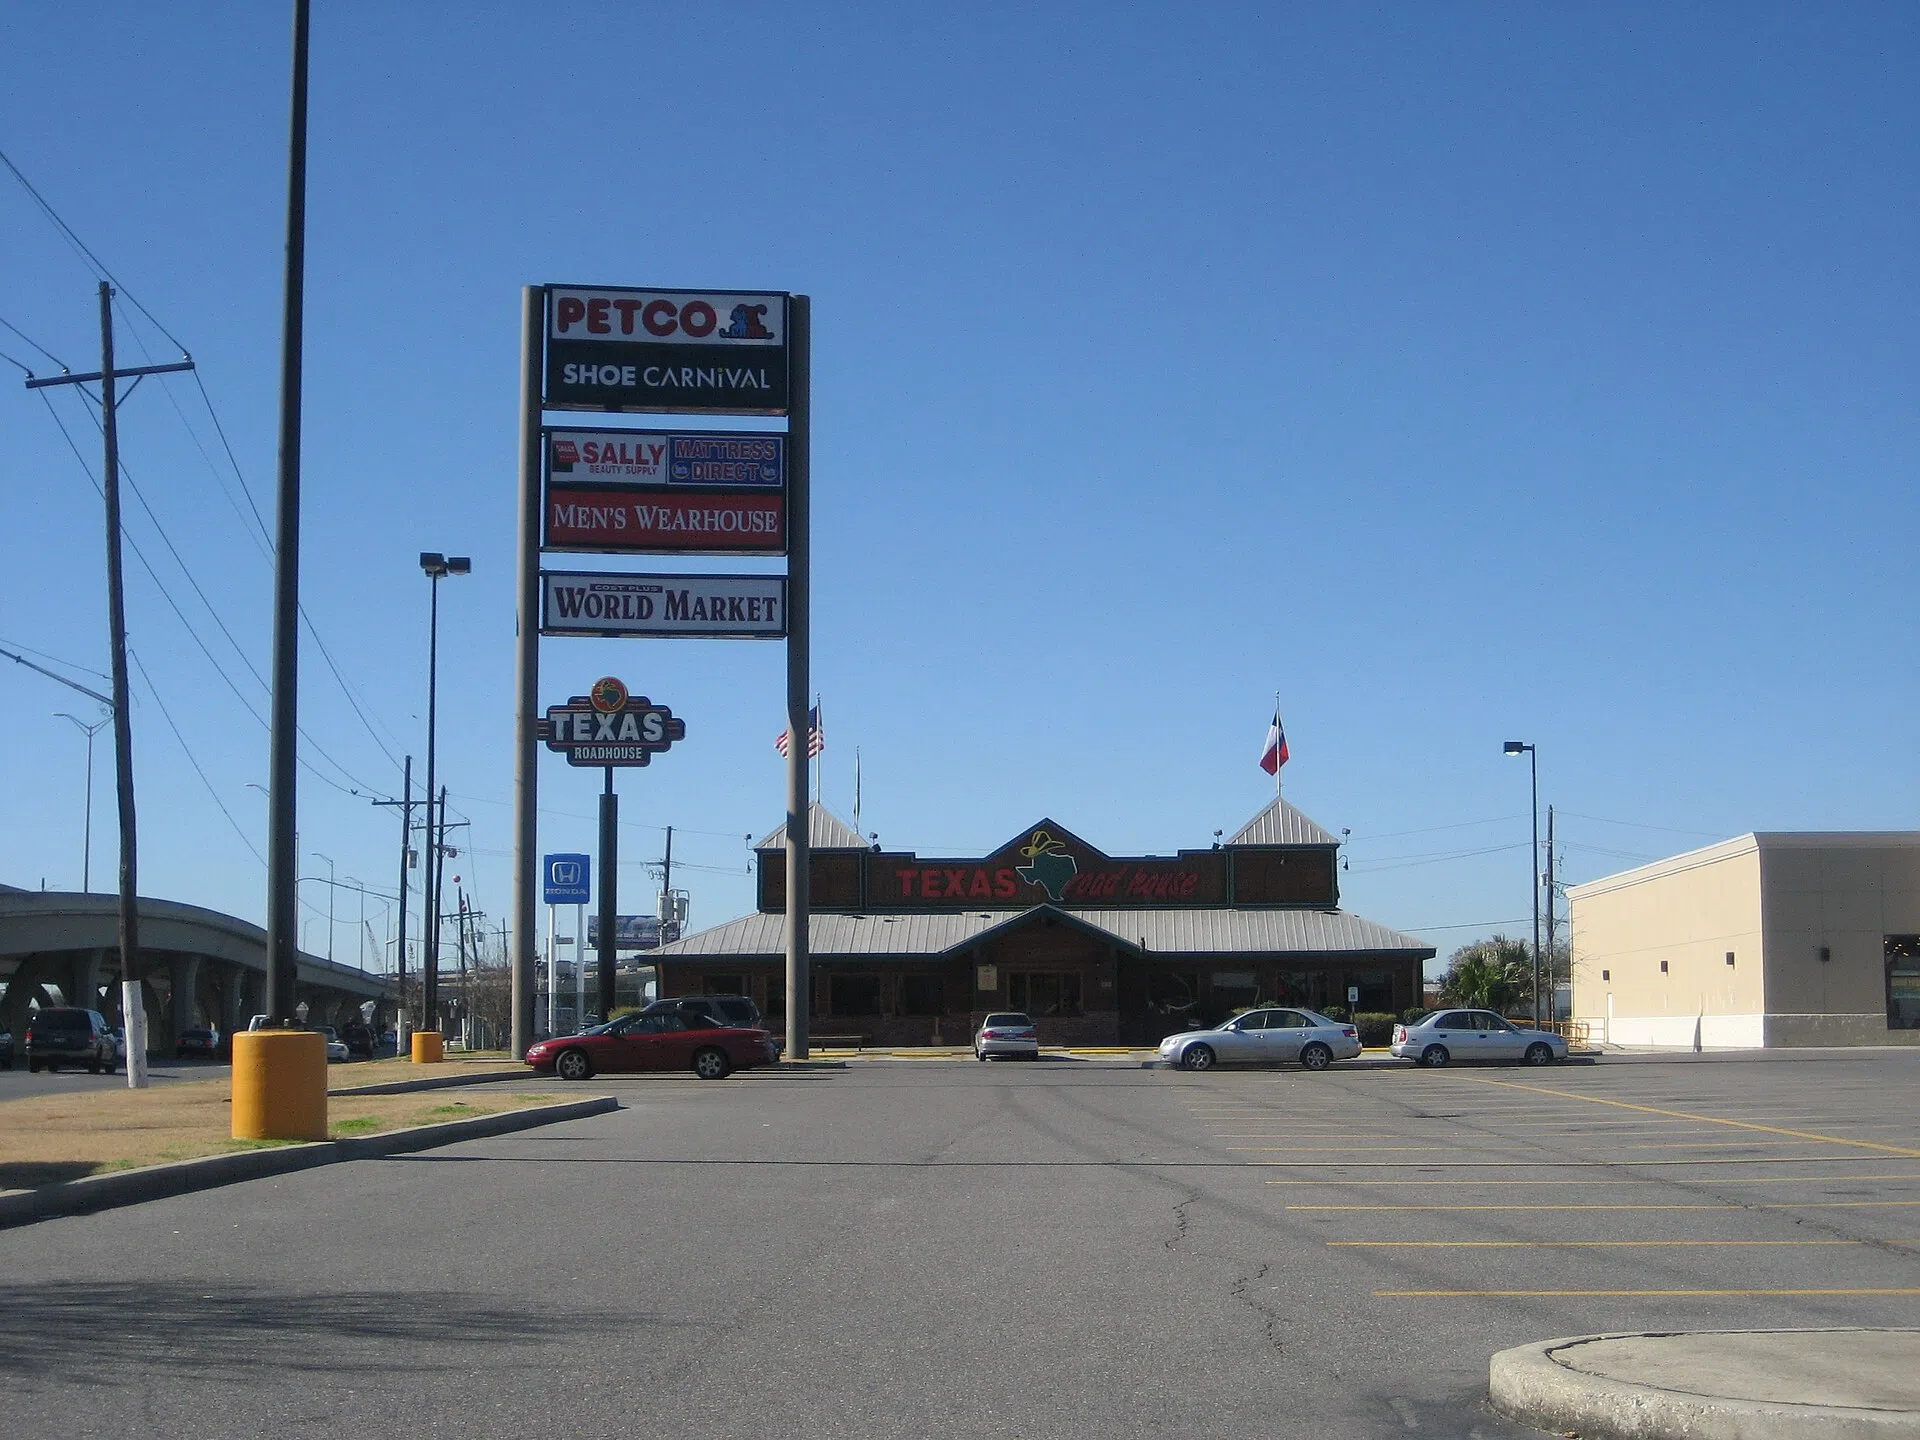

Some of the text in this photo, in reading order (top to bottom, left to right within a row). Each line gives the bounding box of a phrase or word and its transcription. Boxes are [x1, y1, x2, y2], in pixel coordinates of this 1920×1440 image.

[557, 297, 717, 337] PETCO
[563, 363, 636, 386] SHOE
[582, 441, 665, 465] SALLY
[674, 439, 776, 460] MATTRESS
[589, 464, 657, 475] BEAUTY SUPPLY
[691, 461, 760, 481] DIRECT
[553, 504, 778, 533] MEN'S WEARHOUSE
[594, 584, 624, 592] COST
[554, 586, 778, 622] WORLD MARKET
[550, 712, 664, 742] TEXAS
[574, 746, 643, 760] ROADHOUSE
[895, 868, 1018, 898] TEXAS
